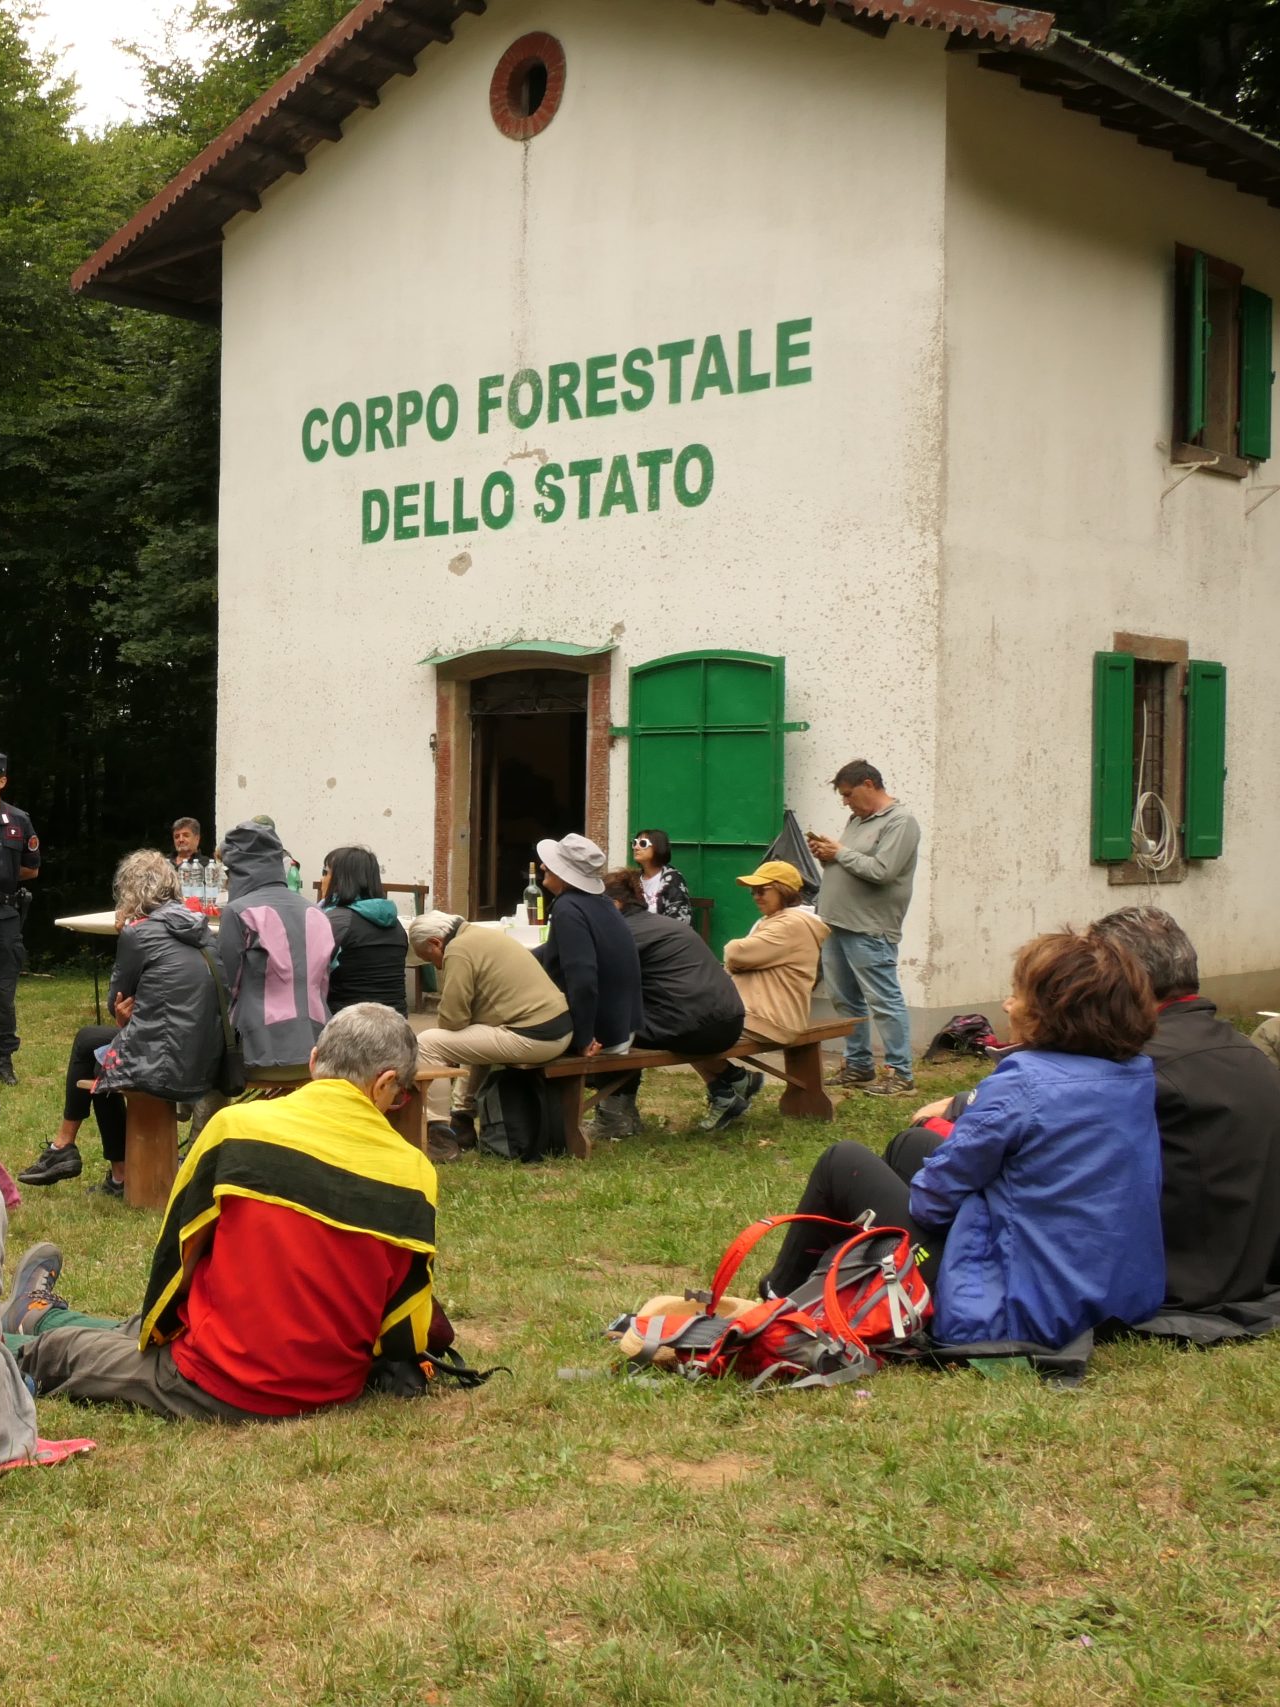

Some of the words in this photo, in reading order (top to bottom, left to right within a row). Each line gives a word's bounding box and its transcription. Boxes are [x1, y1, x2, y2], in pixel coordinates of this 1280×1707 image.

[302, 383, 459, 462] CORPO
[478, 317, 813, 434] FORESTALE
[362, 471, 514, 544] DELLO
[533, 443, 714, 523] STATO
